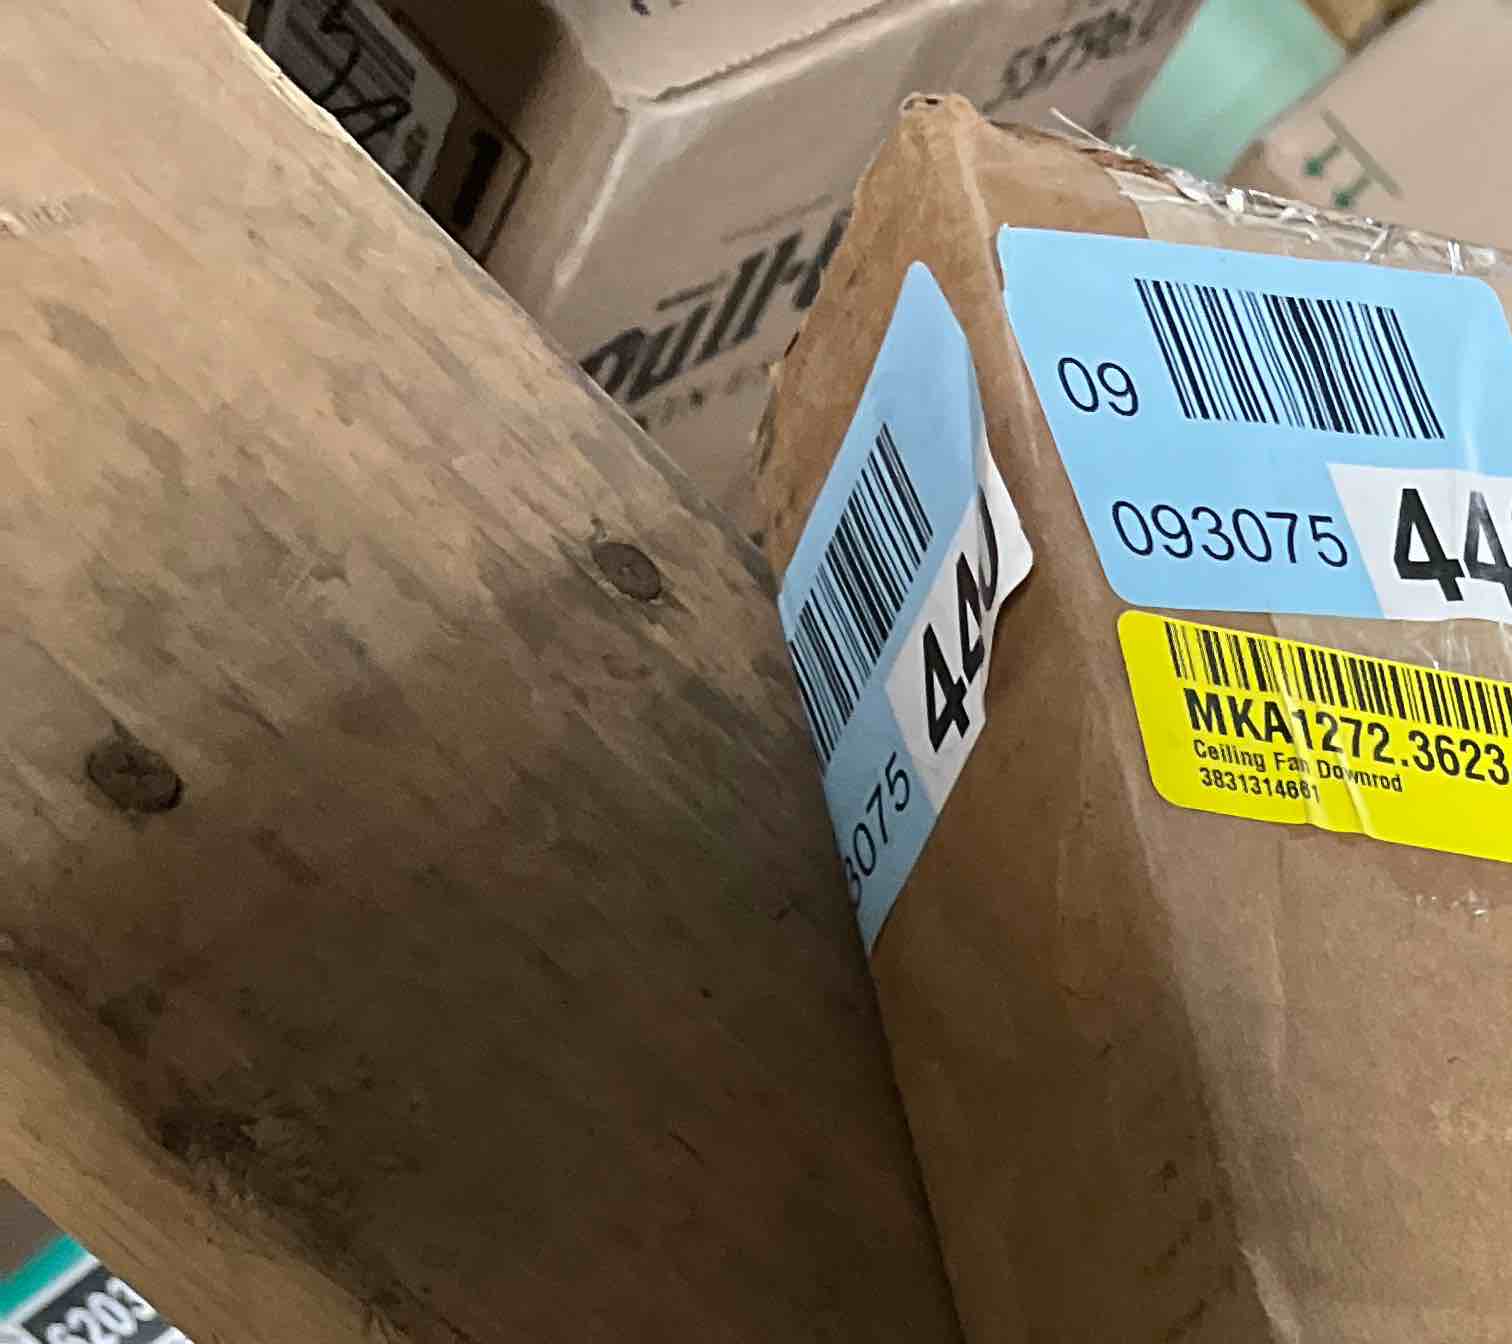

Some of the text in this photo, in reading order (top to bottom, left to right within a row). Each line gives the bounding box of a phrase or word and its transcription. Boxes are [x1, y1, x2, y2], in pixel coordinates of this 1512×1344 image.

[1057, 357, 1139, 416] 09
[1112, 500, 1349, 567] 093075
[1193, 739, 1403, 793] Ceiling Fan Downrod
[1200, 767, 1320, 803] 3831314661
